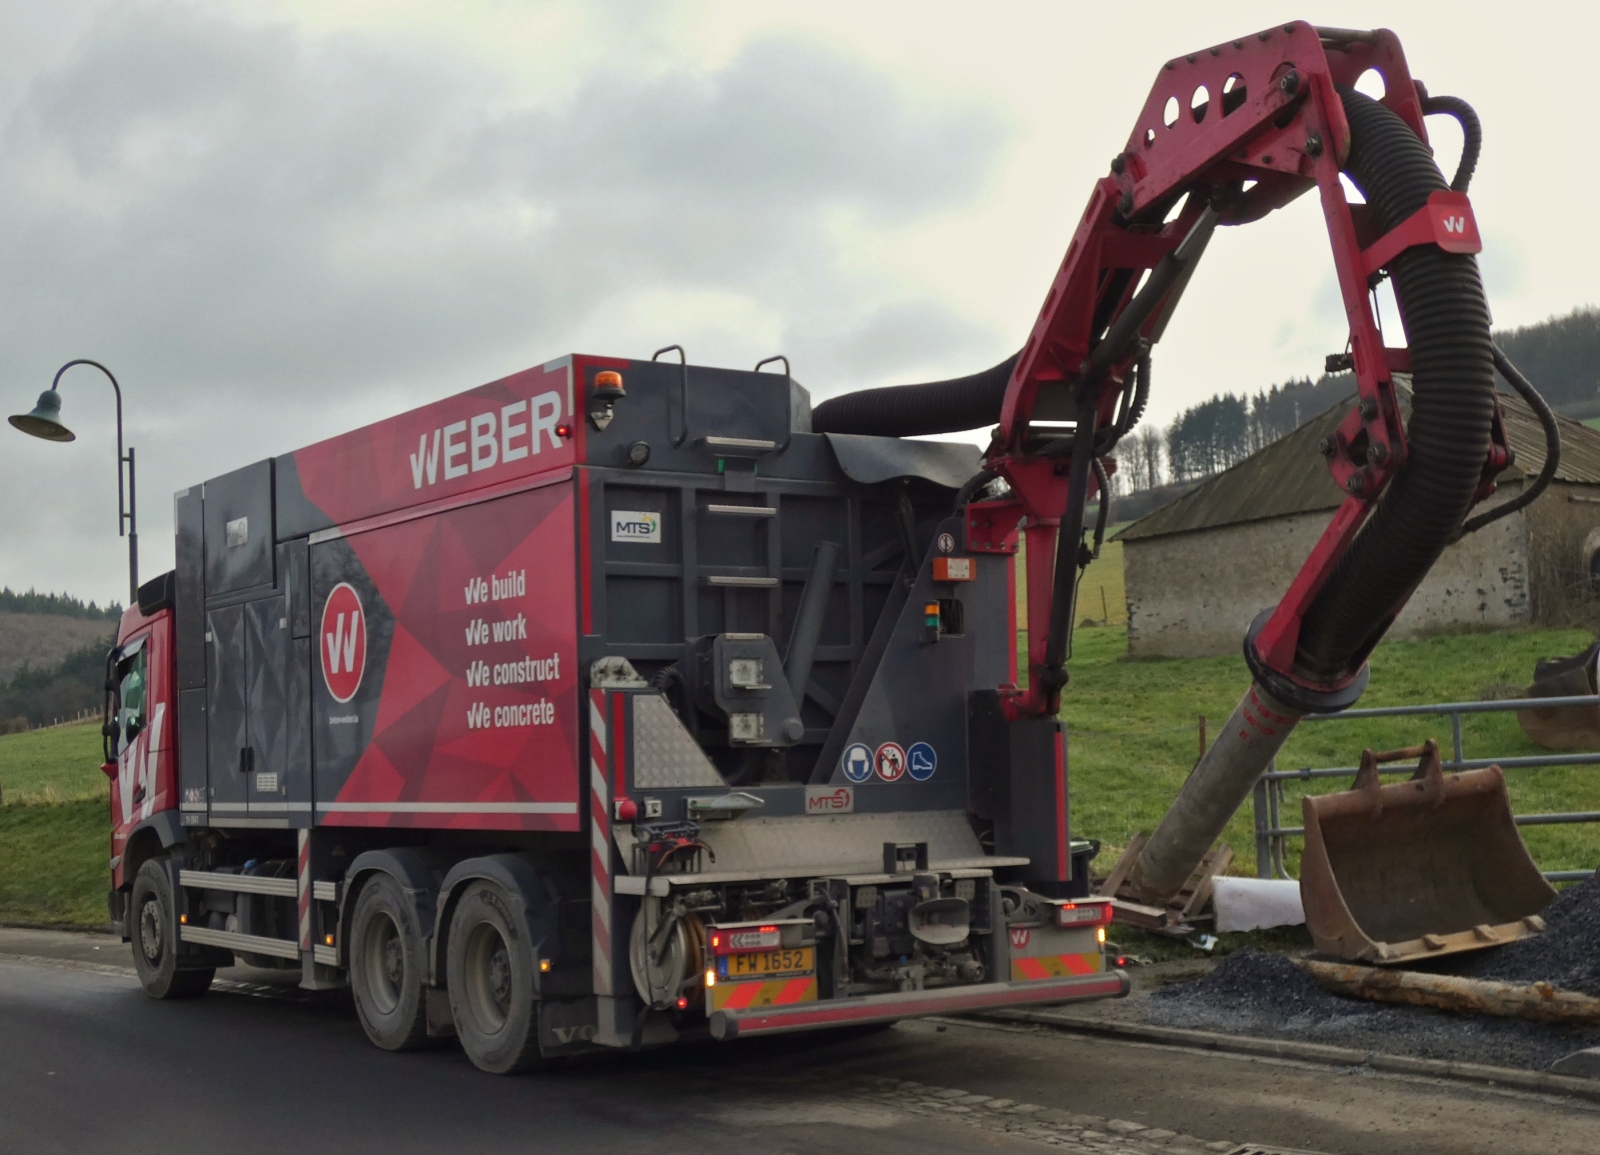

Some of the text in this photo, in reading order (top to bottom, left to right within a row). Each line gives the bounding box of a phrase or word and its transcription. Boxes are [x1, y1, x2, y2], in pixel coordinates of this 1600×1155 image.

[410, 391, 563, 490] WEBER
[616, 521, 651, 534] MTS
[464, 569, 526, 605] We build
[326, 610, 359, 675] W
[465, 612, 527, 646] We work
[466, 652, 560, 687] We construct
[467, 698, 555, 729] We concrete
[809, 795, 845, 809] MTS
[736, 953, 758, 973] FW
[764, 951, 804, 971] 1652
